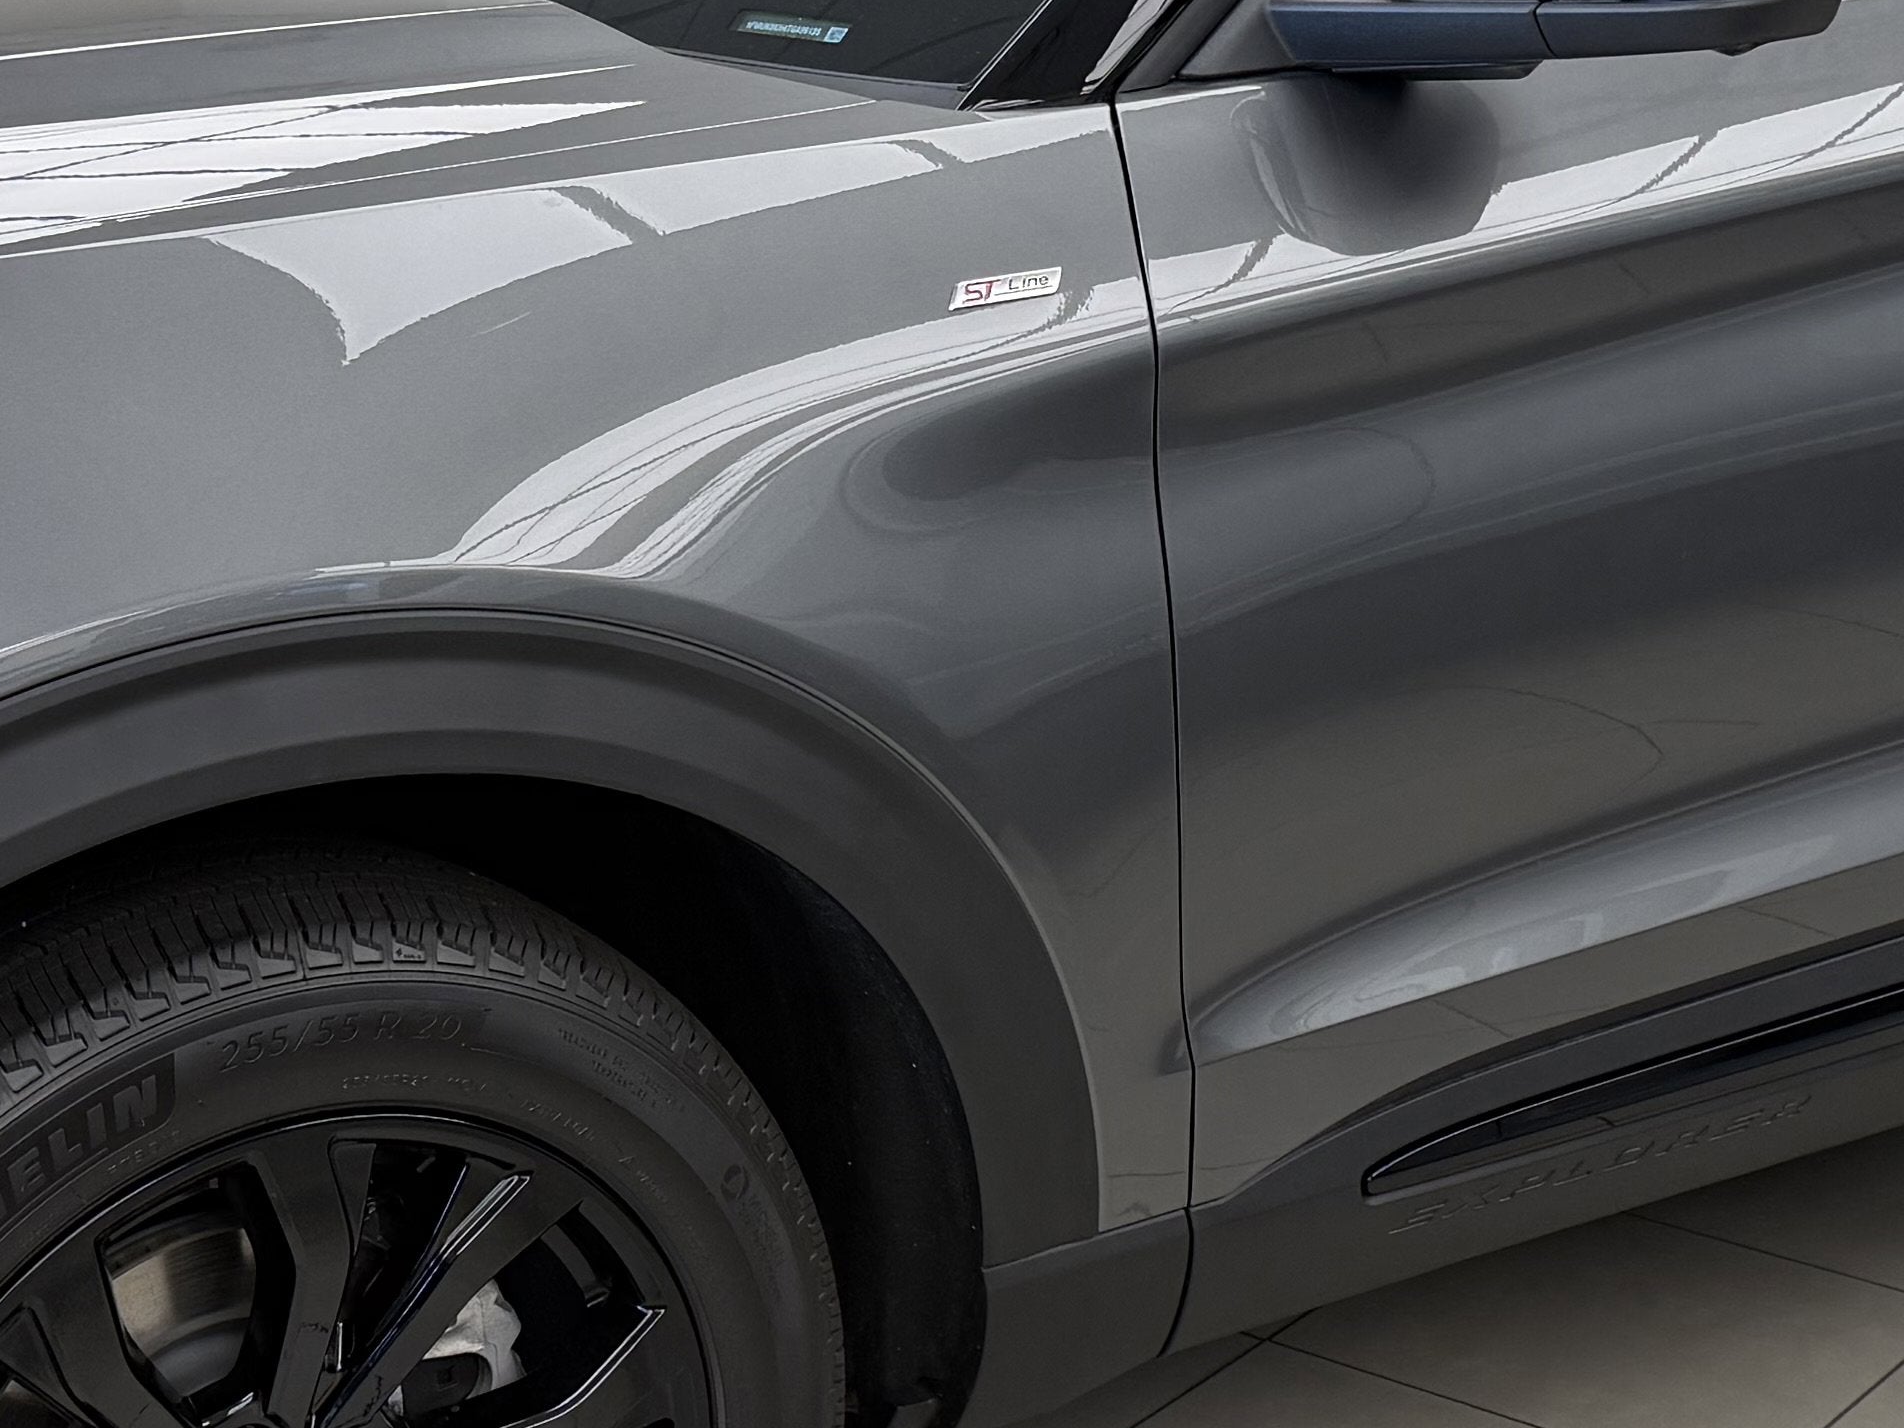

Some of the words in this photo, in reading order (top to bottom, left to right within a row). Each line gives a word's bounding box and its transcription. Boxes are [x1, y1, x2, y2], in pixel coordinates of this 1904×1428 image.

[961, 279, 1001, 305] ST
[1007, 273, 1050, 292] Line
[1388, 1094, 1813, 1235] EXPLORER
